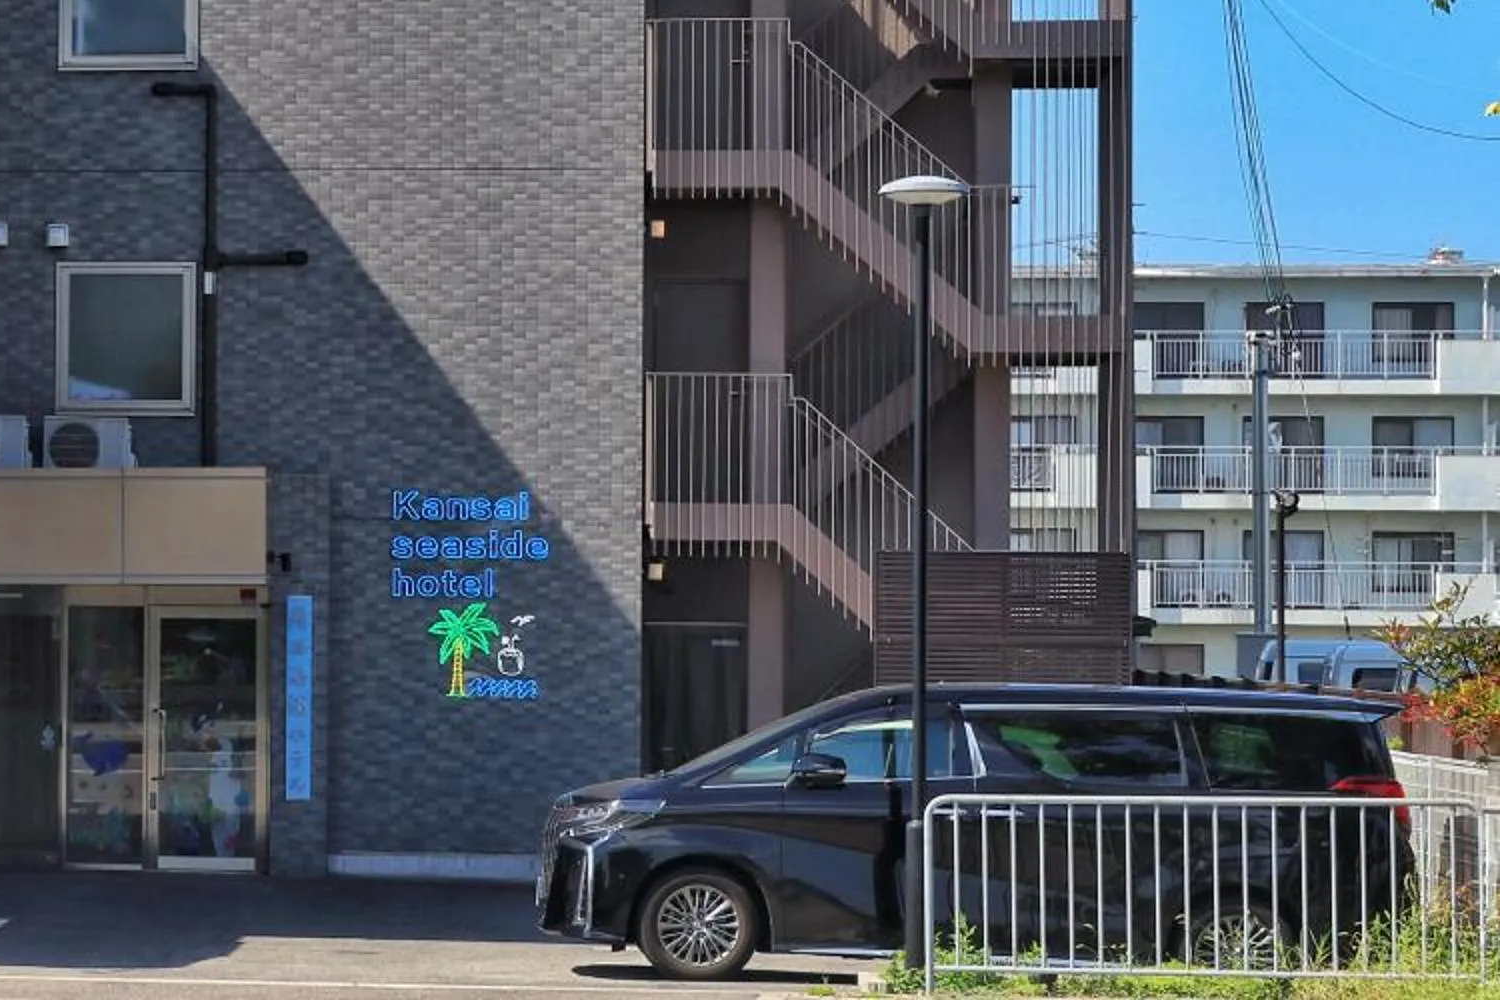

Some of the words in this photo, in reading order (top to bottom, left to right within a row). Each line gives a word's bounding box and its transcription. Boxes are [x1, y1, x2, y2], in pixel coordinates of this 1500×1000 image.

[392, 490, 530, 520] Kansai
[391, 529, 549, 559] seaside
[391, 567, 496, 597] hotel
